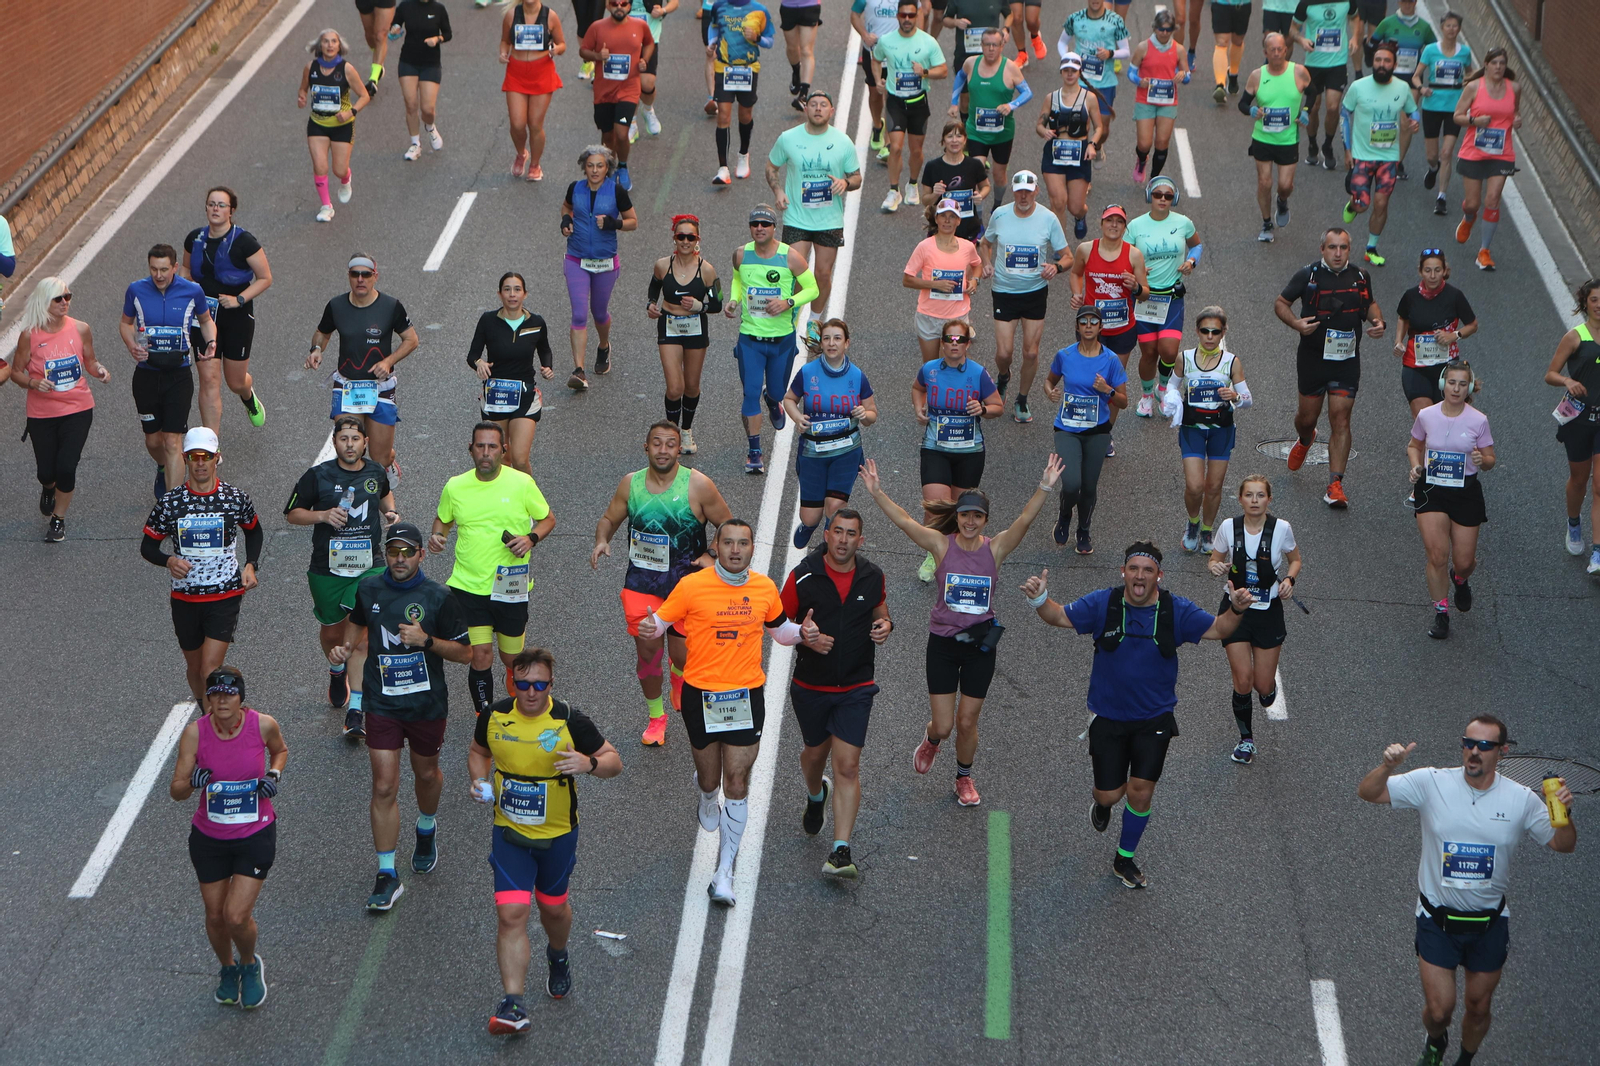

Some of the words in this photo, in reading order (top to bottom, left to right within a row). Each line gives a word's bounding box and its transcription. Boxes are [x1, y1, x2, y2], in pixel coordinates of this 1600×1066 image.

[1106, 301, 1124, 309] ZURICH
[157, 328, 178, 336] ZURICH
[58, 357, 77, 368] ZURICH
[497, 381, 518, 389] ZURICH
[1075, 397, 1094, 405] ZURICH
[825, 422, 847, 431] ZURICH
[1440, 453, 1461, 461] ZURICH
[194, 519, 218, 527] ZURICH
[193, 532, 210, 541] 11529
[642, 535, 664, 545] ZURICH
[345, 542, 367, 550] ZURICH
[345, 555, 358, 563] 9921
[510, 568, 527, 576] ZURICH
[962, 577, 986, 587] ZURICH
[393, 655, 419, 665] ZURICH
[395, 679, 415, 687] MIGUEL
[718, 705, 737, 714] 11146
[723, 714, 734, 722] EMI
[225, 783, 252, 793] ZURICH
[513, 785, 541, 795] ZURICH
[511, 798, 531, 808] 11747
[224, 807, 241, 815] BETTY
[515, 806, 540, 817] BELTRAN
[1461, 846, 1489, 855] ZURICH
[1457, 860, 1480, 871] 11757
